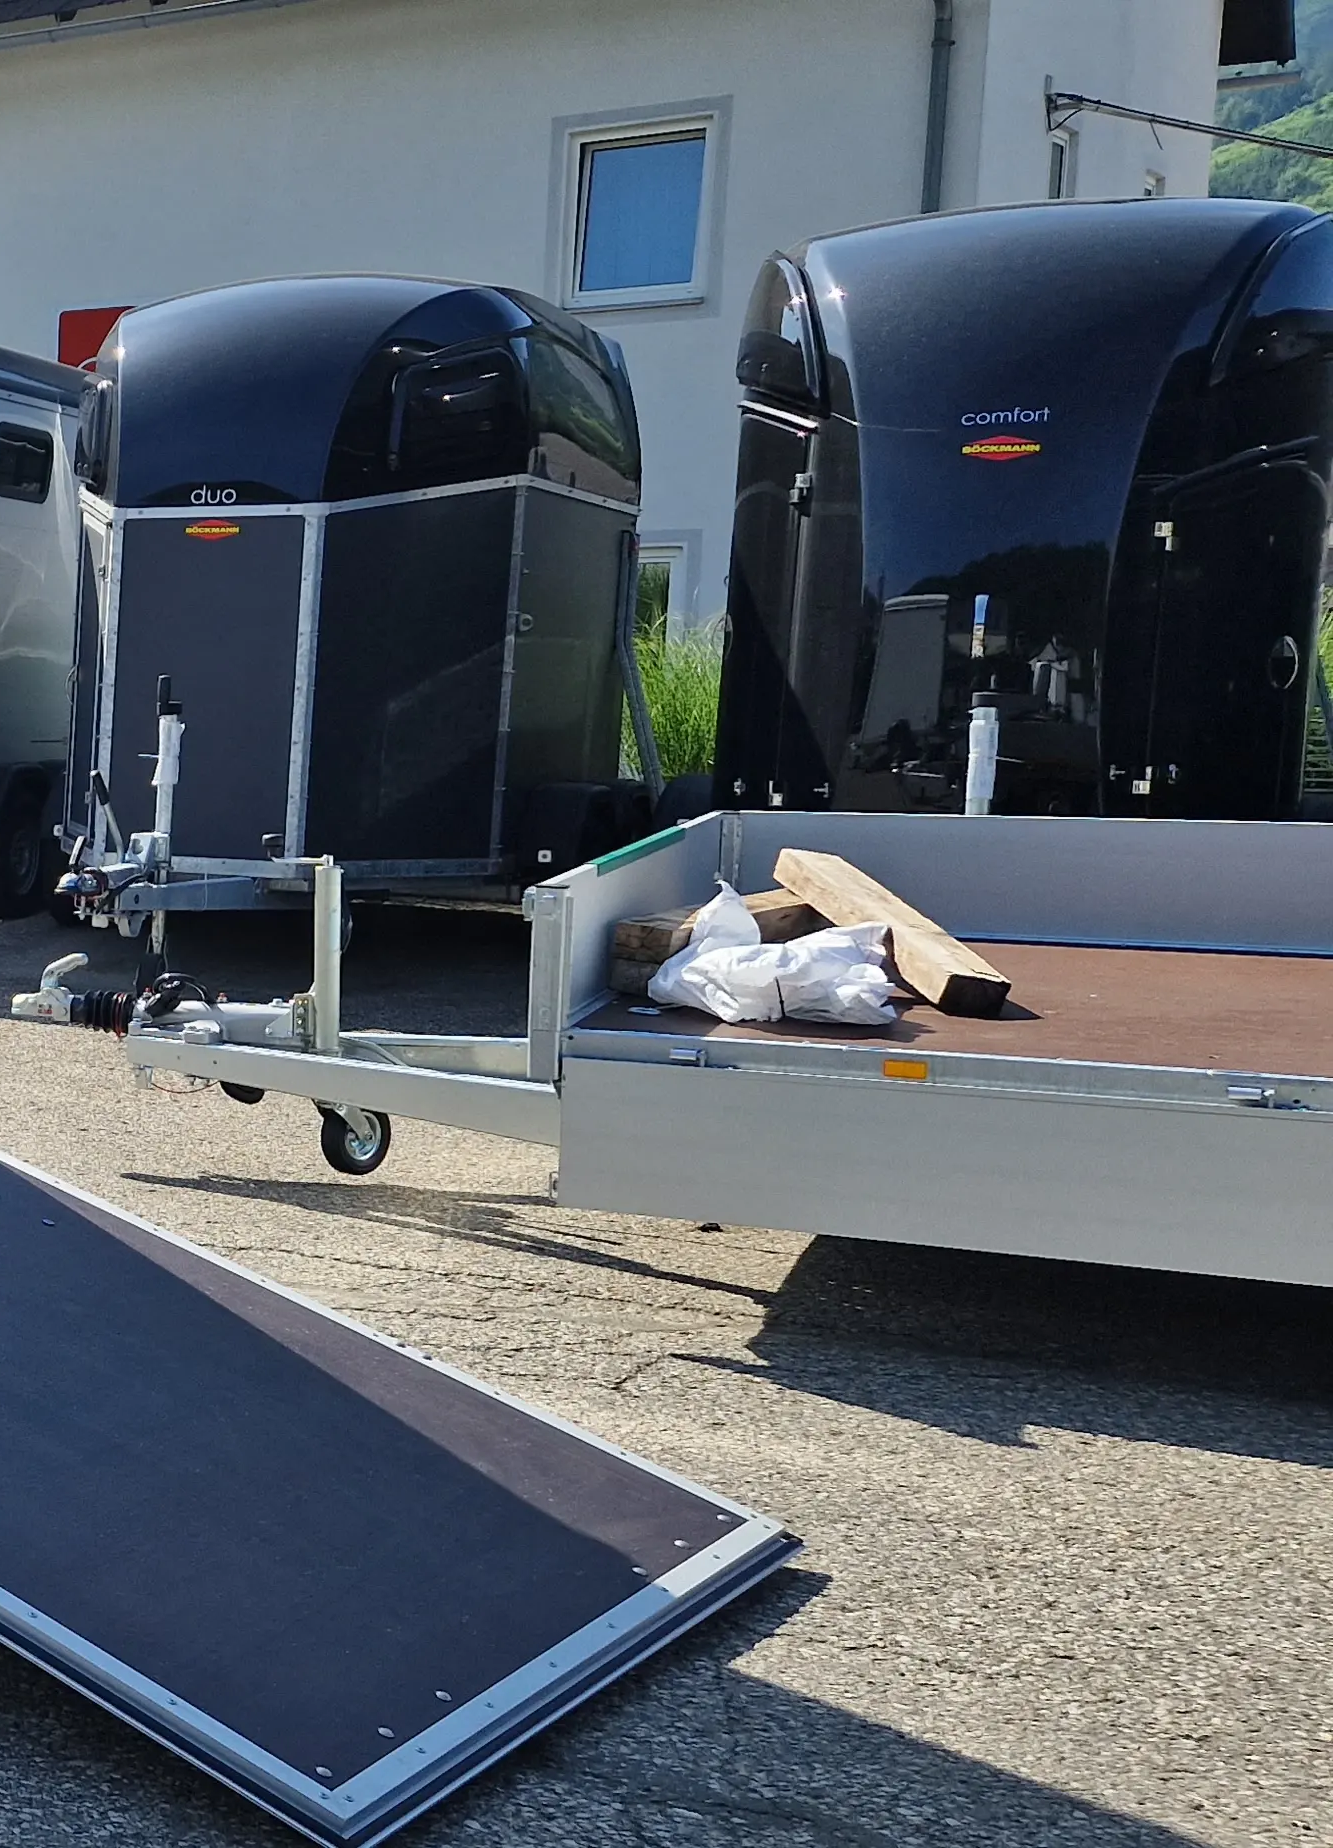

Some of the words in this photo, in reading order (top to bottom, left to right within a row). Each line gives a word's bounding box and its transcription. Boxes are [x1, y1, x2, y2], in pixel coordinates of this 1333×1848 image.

[961, 406, 1051, 426] comfort
[961, 443, 1041, 454] BÖCKMANN
[190, 484, 237, 504] duo
[185, 526, 240, 534] BÖCKMANN
